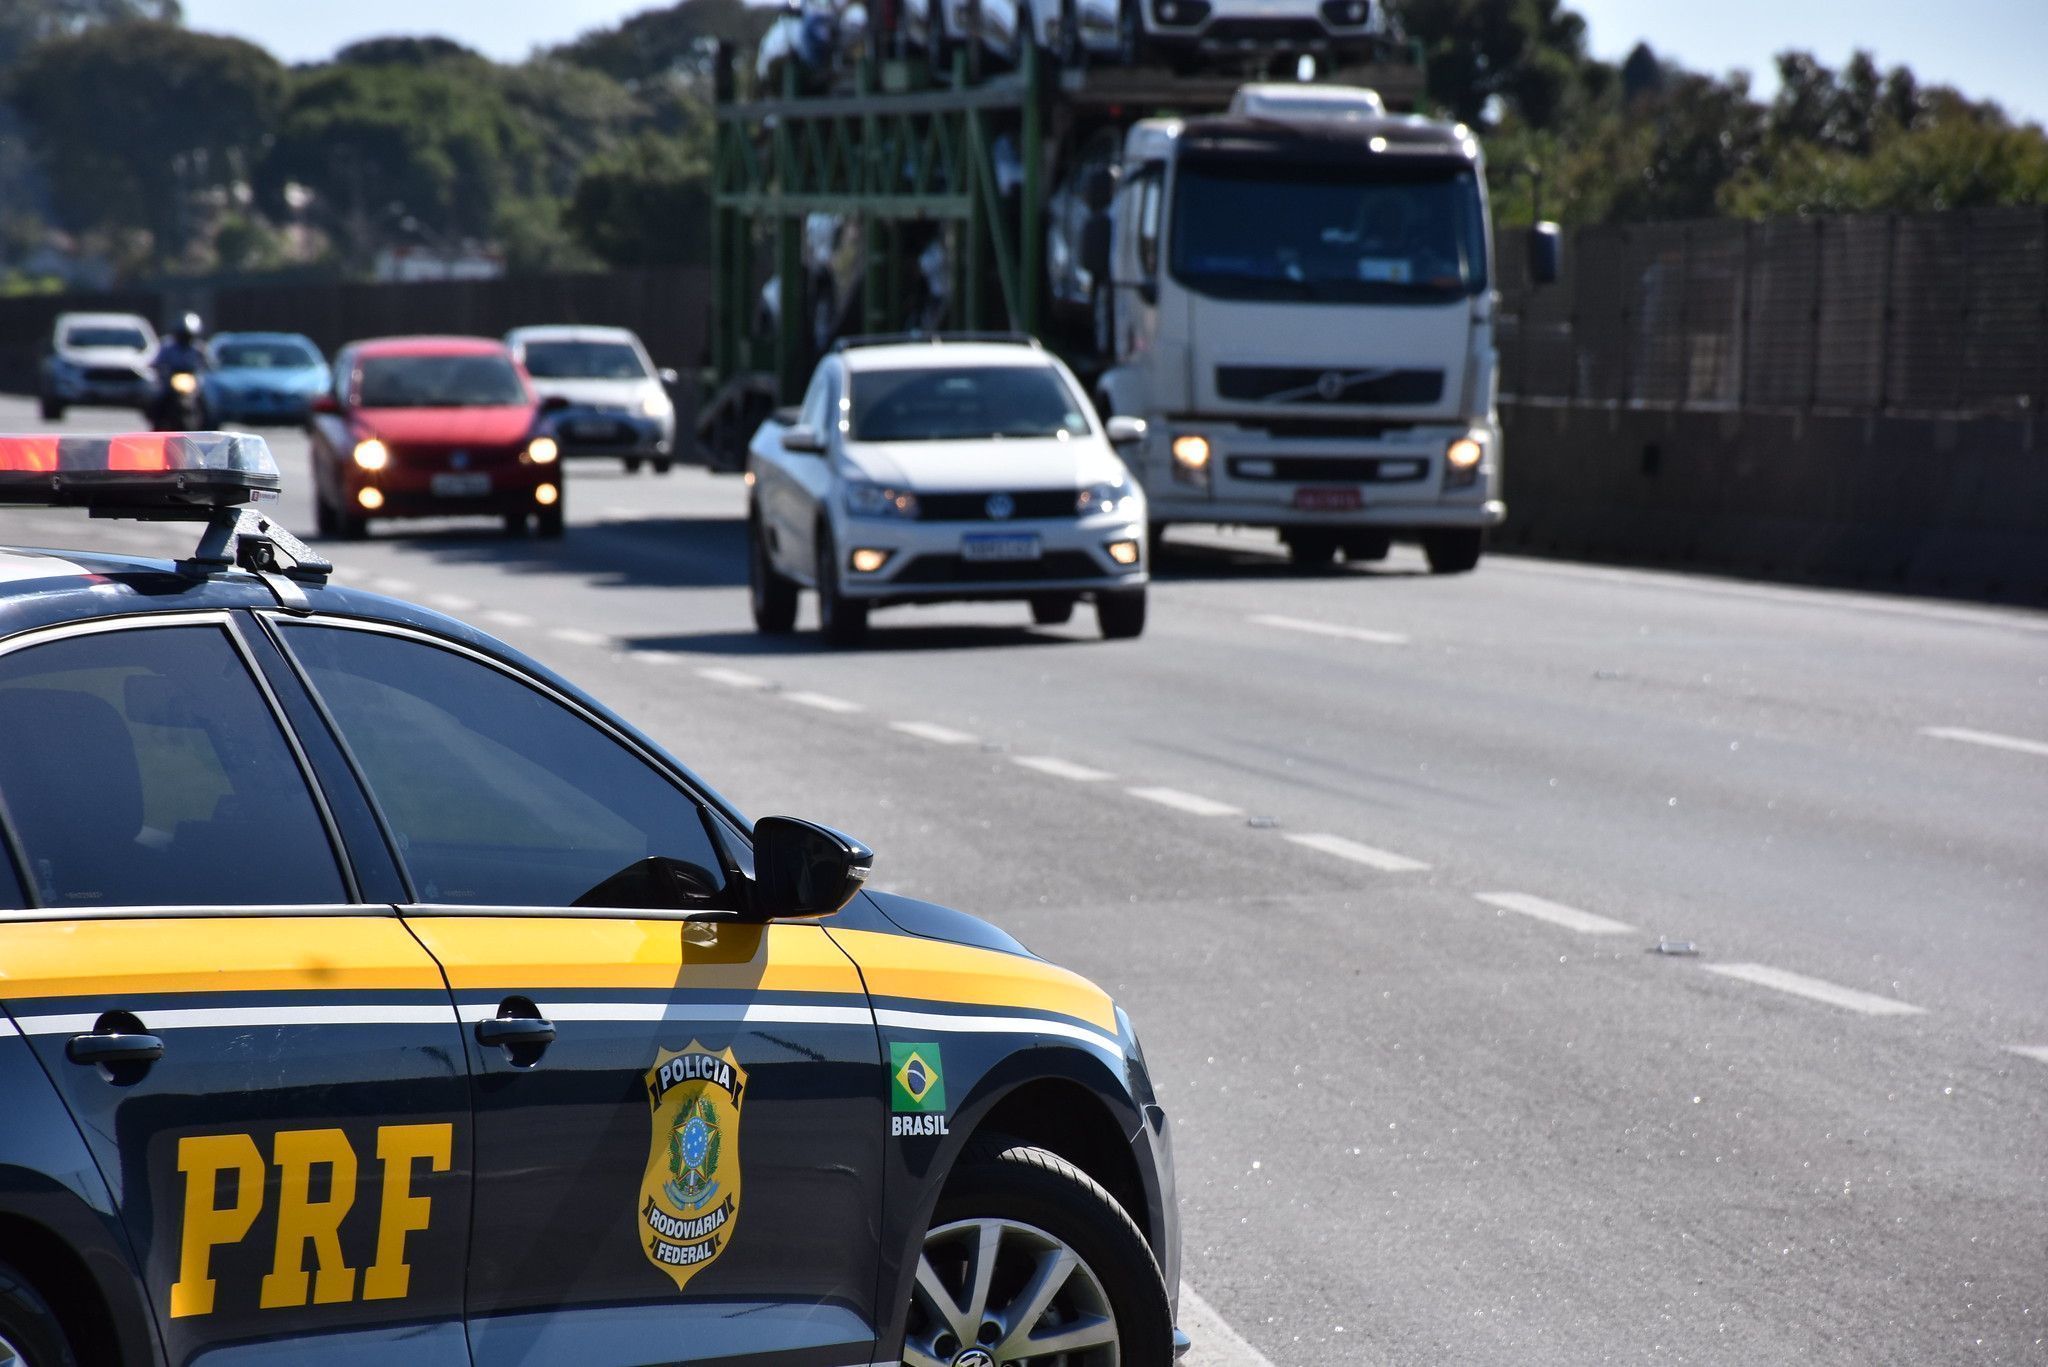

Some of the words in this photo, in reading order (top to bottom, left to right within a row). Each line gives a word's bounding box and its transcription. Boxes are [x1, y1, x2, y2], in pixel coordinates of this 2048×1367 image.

[660, 1055, 730, 1090] POLÍCIA
[892, 1115, 949, 1136] BRASIL
[170, 1123, 453, 1318] PRF
[657, 1242, 712, 1265] FEDERAL
